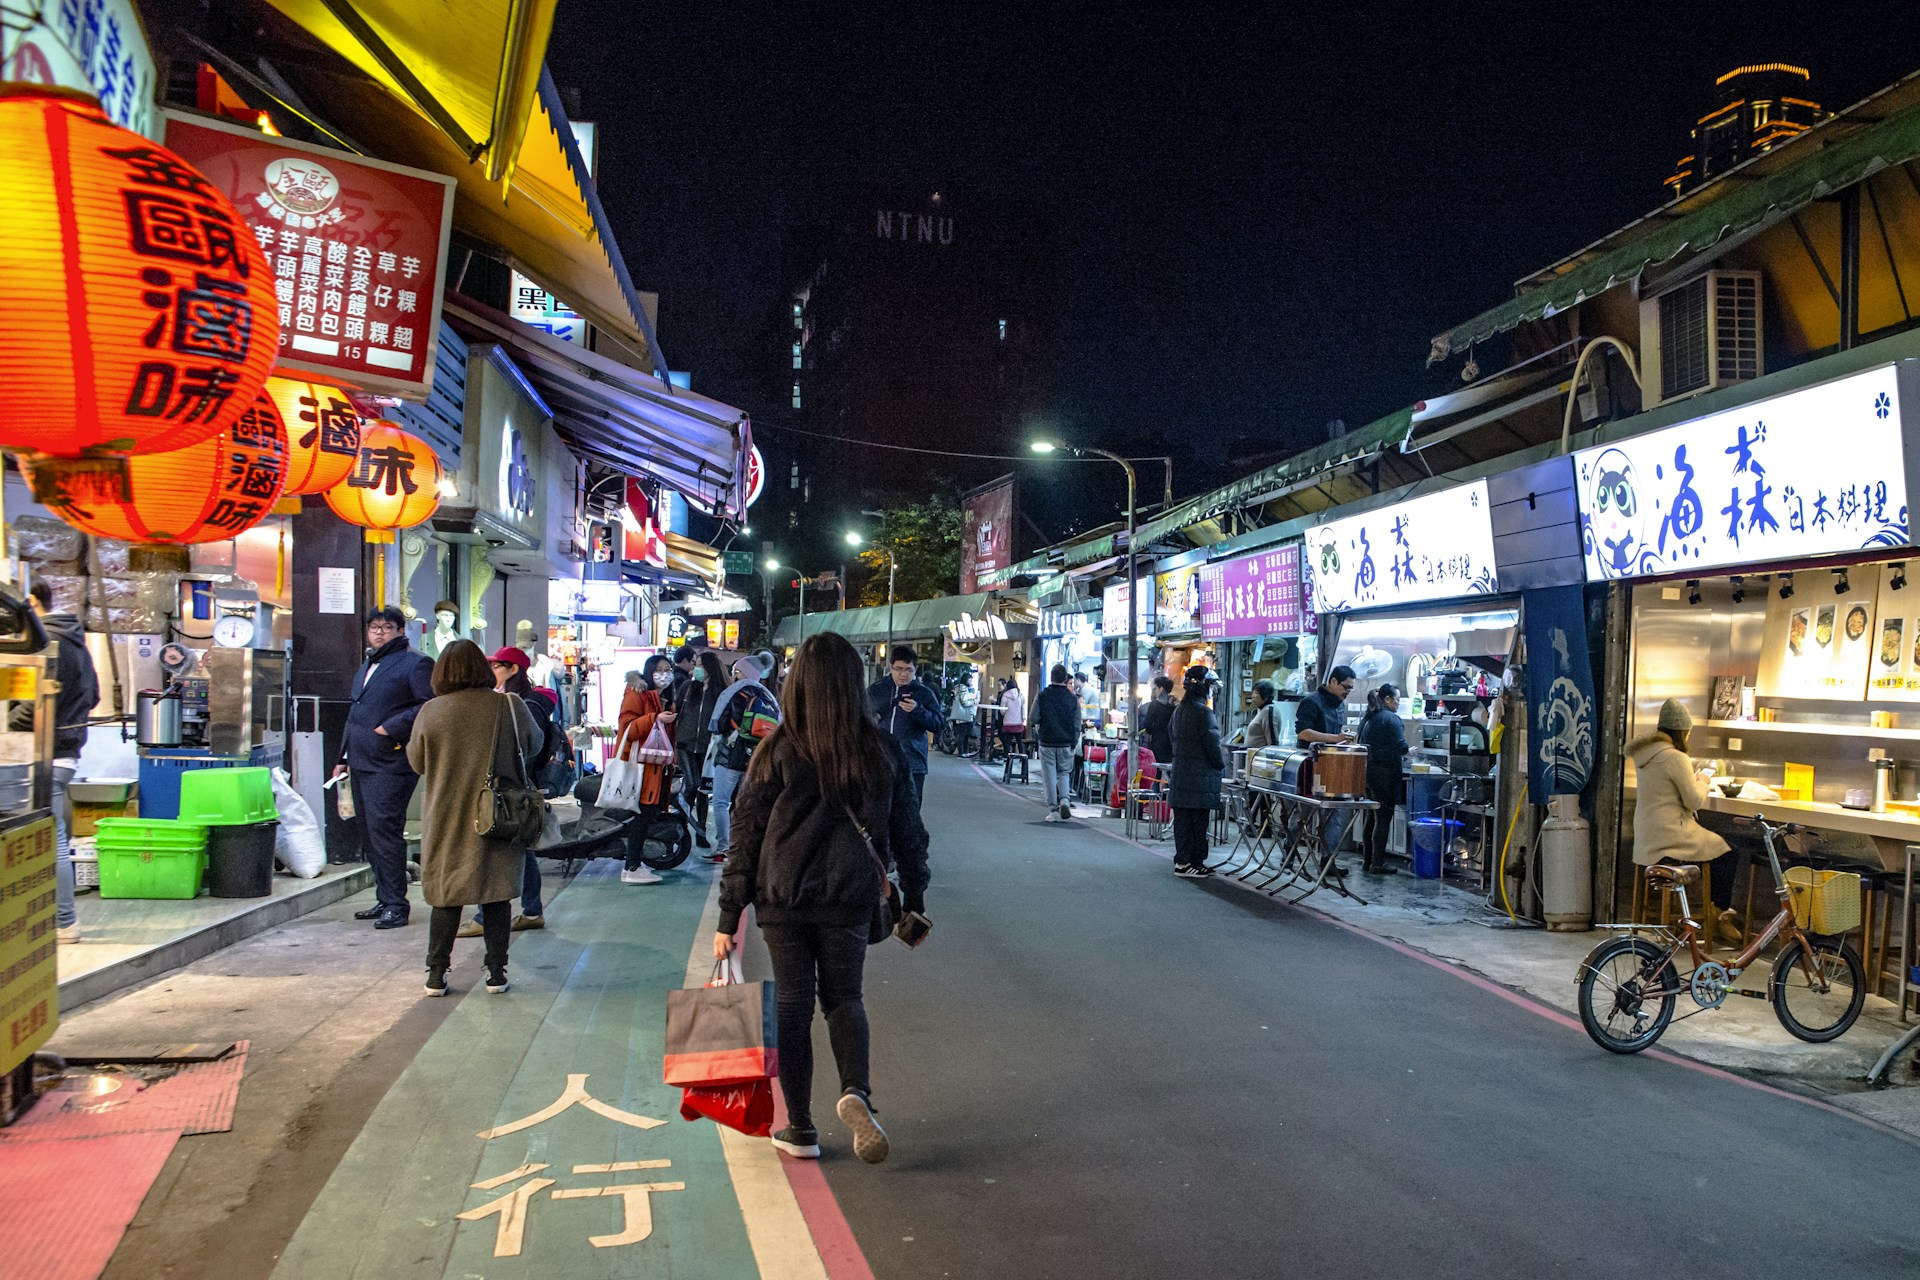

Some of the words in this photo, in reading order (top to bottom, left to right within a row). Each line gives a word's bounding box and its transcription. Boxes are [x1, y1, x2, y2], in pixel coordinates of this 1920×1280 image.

[877, 209, 954, 245] NTNU
[100, 146, 253, 424] 金甌滷味
[296, 235, 324, 333] 高麗菜肉包
[320, 240, 348, 336] 酸菜肉包
[344, 246, 373, 341] 全麥饅頭
[369, 251, 397, 345] 草仔粿
[392, 255, 421, 350] 芋粿翹
[343, 345, 361, 359] 15
[205, 396, 285, 530] 甌滷味
[299, 396, 360, 456] 滷
[348, 446, 418, 496] 味
[1783, 480, 1890, 535] 日本料理
[1225, 580, 1268, 621] 北港豆花
